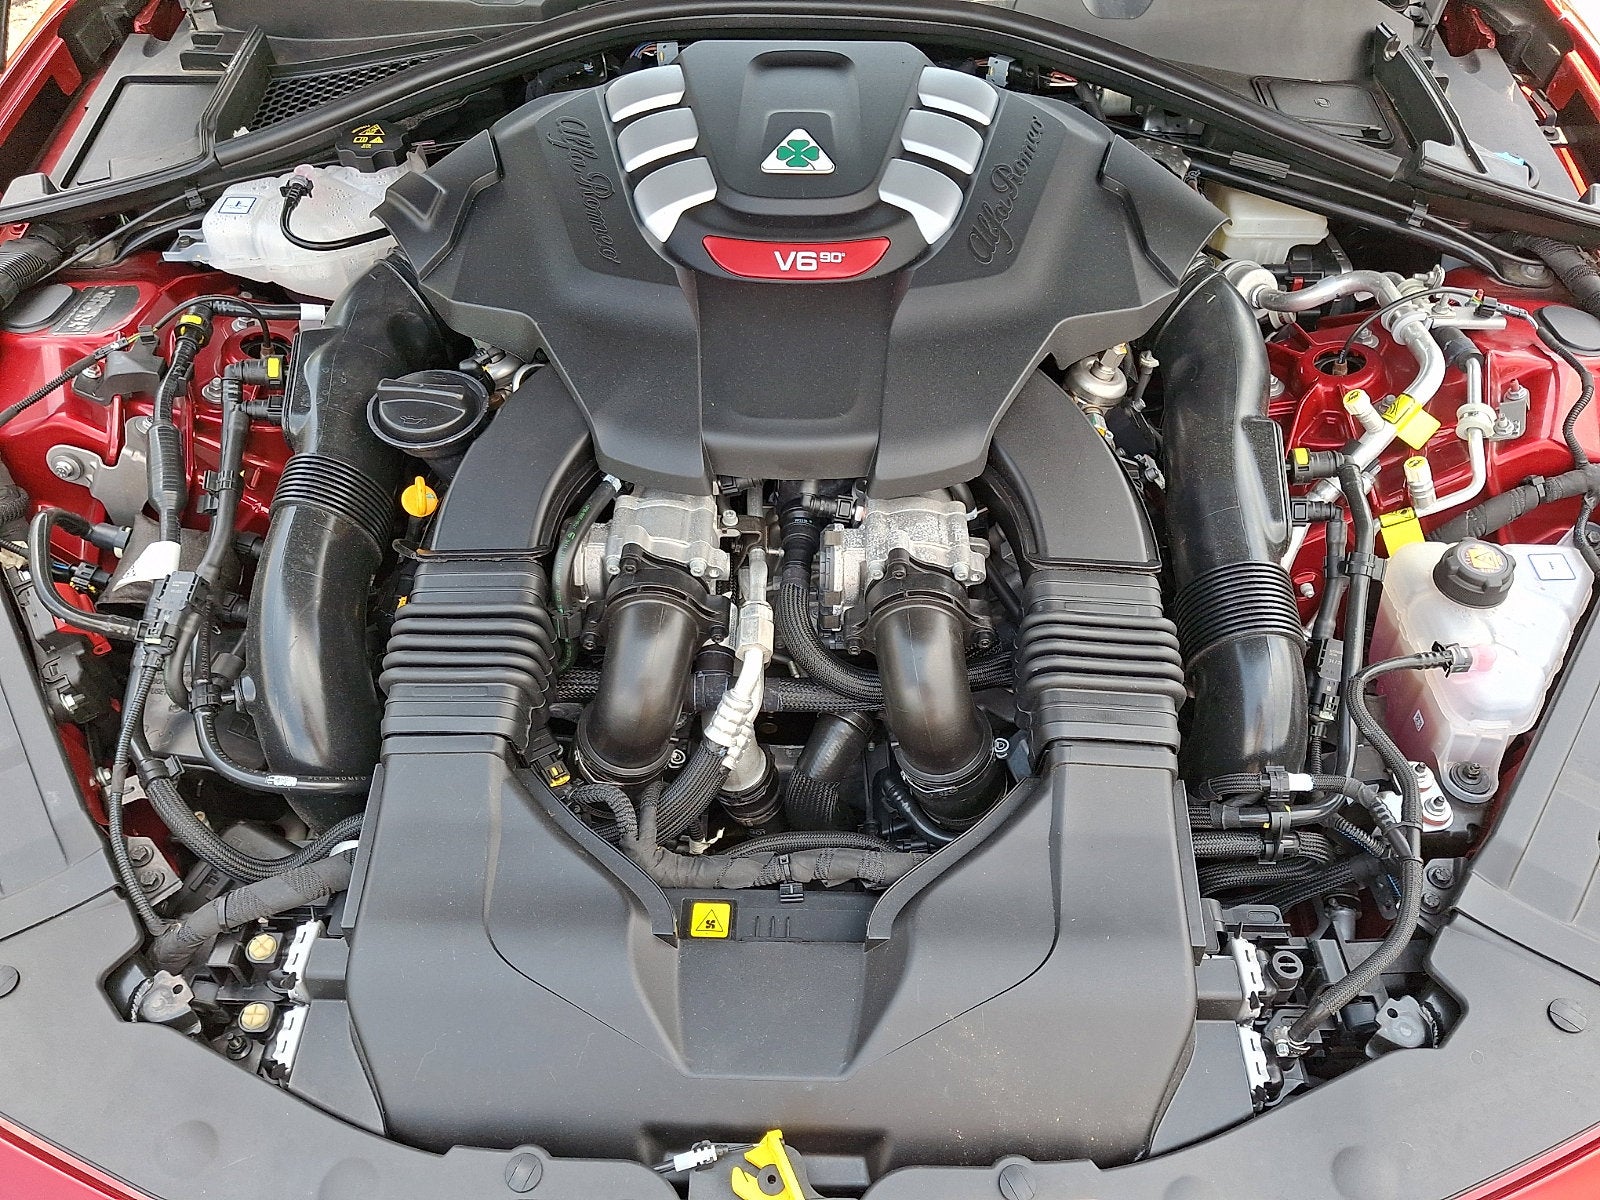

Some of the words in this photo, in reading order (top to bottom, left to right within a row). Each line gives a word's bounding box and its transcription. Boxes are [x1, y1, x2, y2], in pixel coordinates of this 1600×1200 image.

[547, 115, 599, 173] Alfa
[575, 172, 621, 264] Romeo
[991, 115, 1044, 200] Romeo
[969, 198, 1014, 264] Alfa
